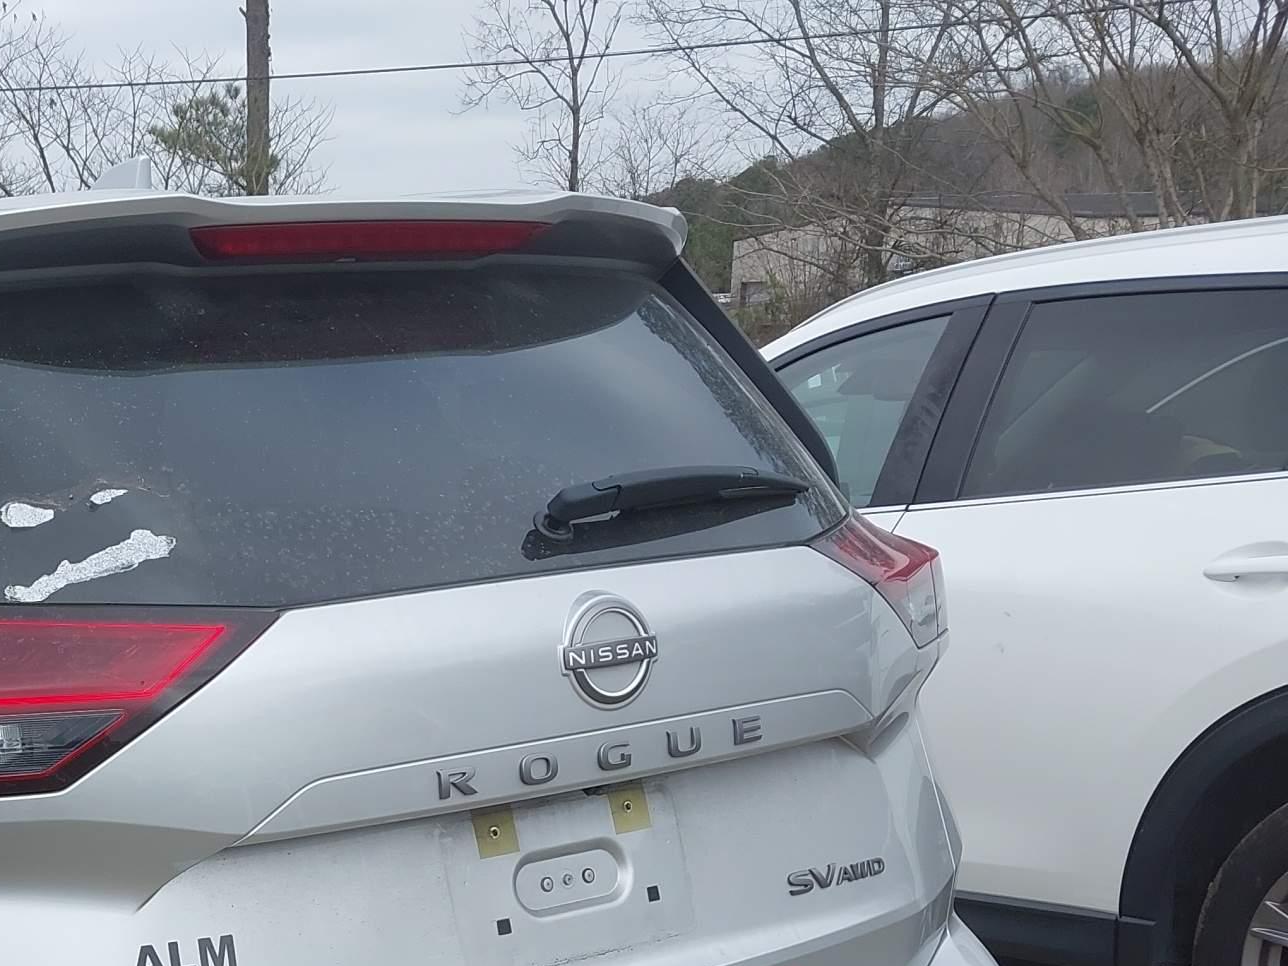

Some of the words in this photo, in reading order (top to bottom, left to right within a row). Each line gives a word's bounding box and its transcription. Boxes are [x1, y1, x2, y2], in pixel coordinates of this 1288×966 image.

[568, 640, 657, 667] NISSAN
[436, 714, 763, 800] ROGUE
[787, 863, 837, 896] SV
[836, 857, 885, 886] AWD
